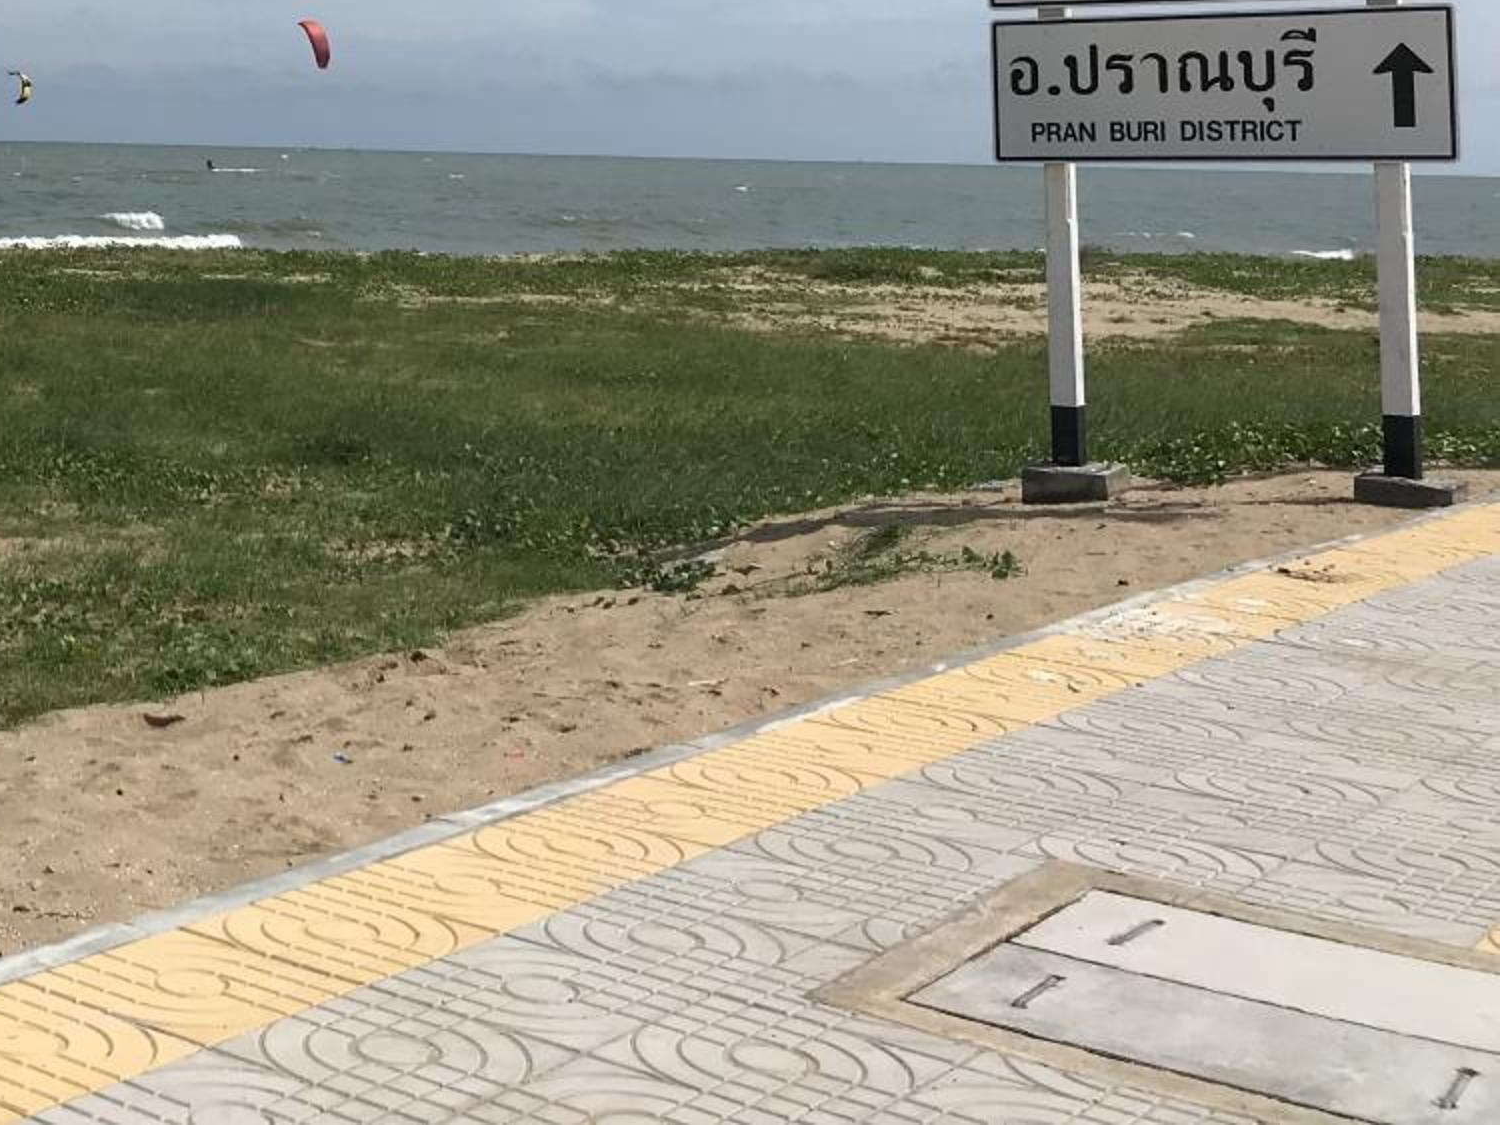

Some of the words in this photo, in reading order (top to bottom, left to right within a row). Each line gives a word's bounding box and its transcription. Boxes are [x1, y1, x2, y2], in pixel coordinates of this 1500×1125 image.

[1008, 27, 1318, 112] อ.ปราณบุรี
[1031, 121, 1096, 143] PRAN
[1109, 120, 1166, 142] BURI
[1180, 119, 1302, 142] DISTRICT
